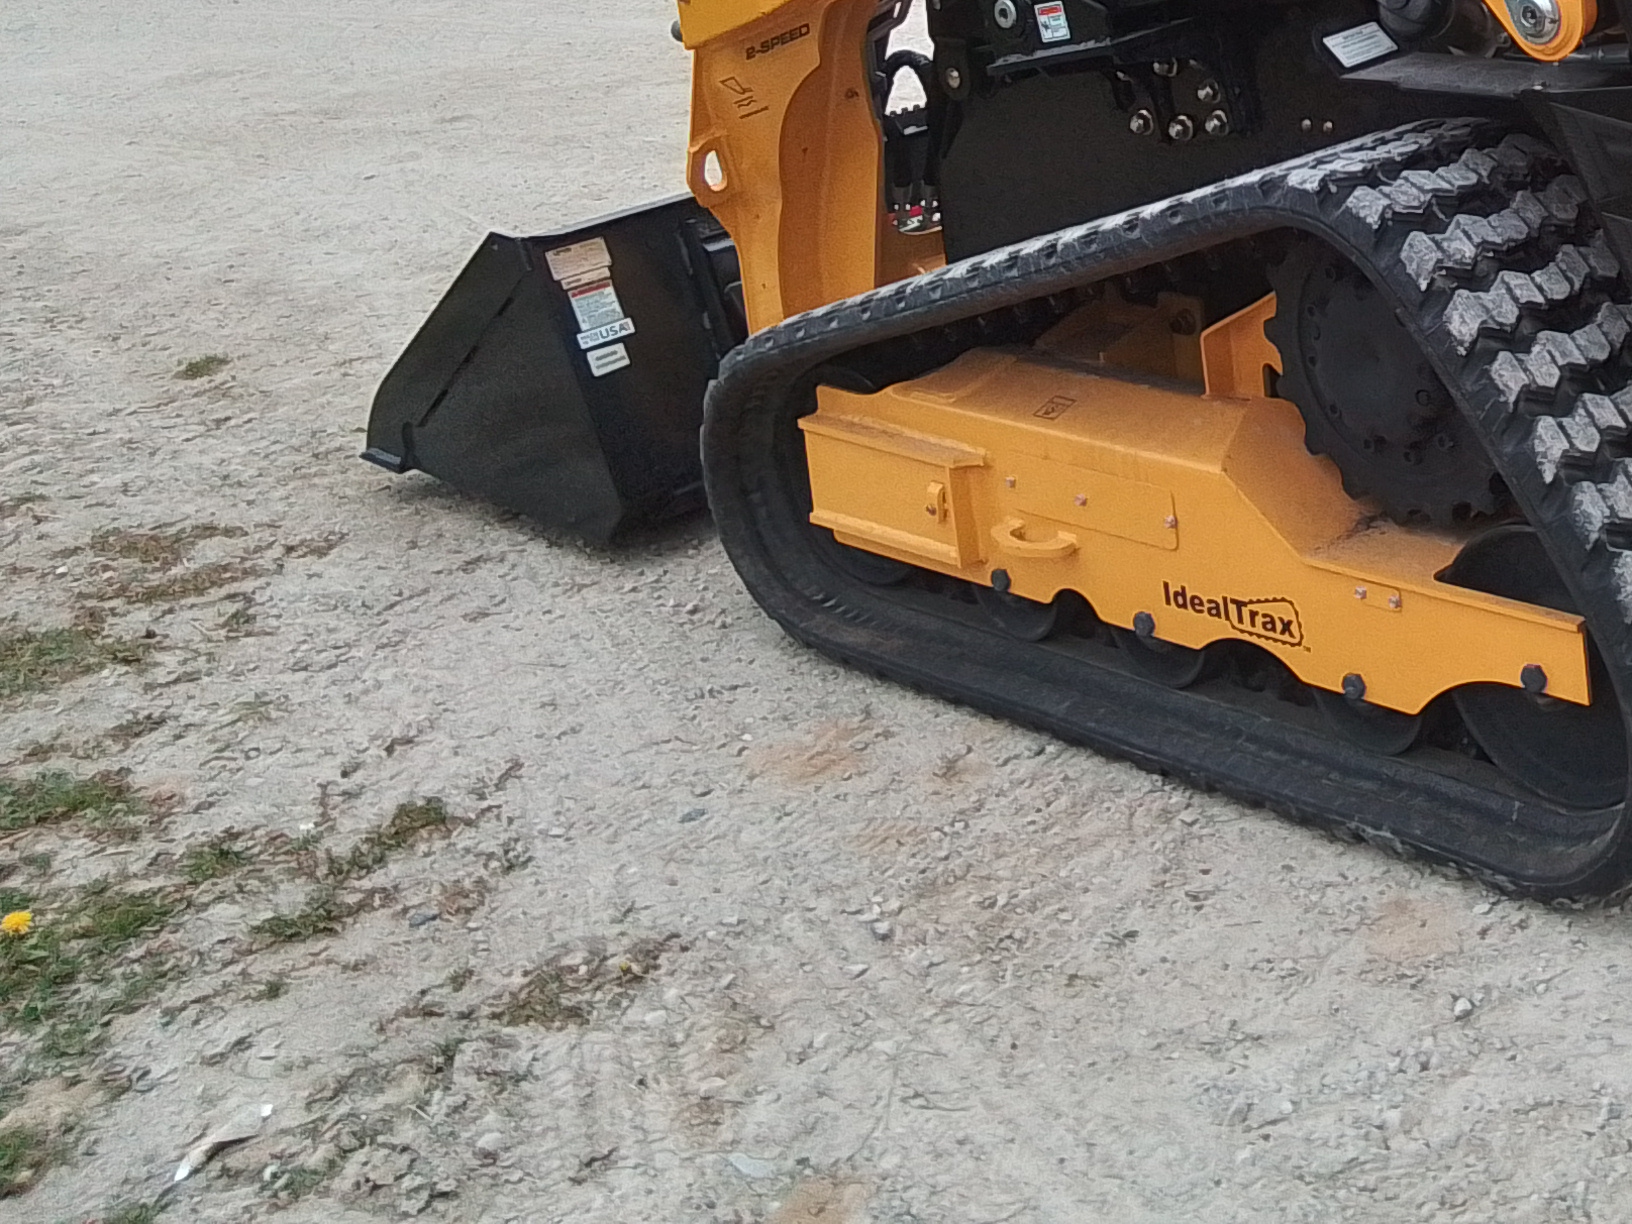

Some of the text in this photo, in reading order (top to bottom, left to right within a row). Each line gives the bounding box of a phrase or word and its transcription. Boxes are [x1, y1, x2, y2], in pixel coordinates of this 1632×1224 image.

[745, 23, 811, 60] 2-SPEED
[600, 322, 627, 340] USA
[1163, 580, 1297, 639] IdealTrax
